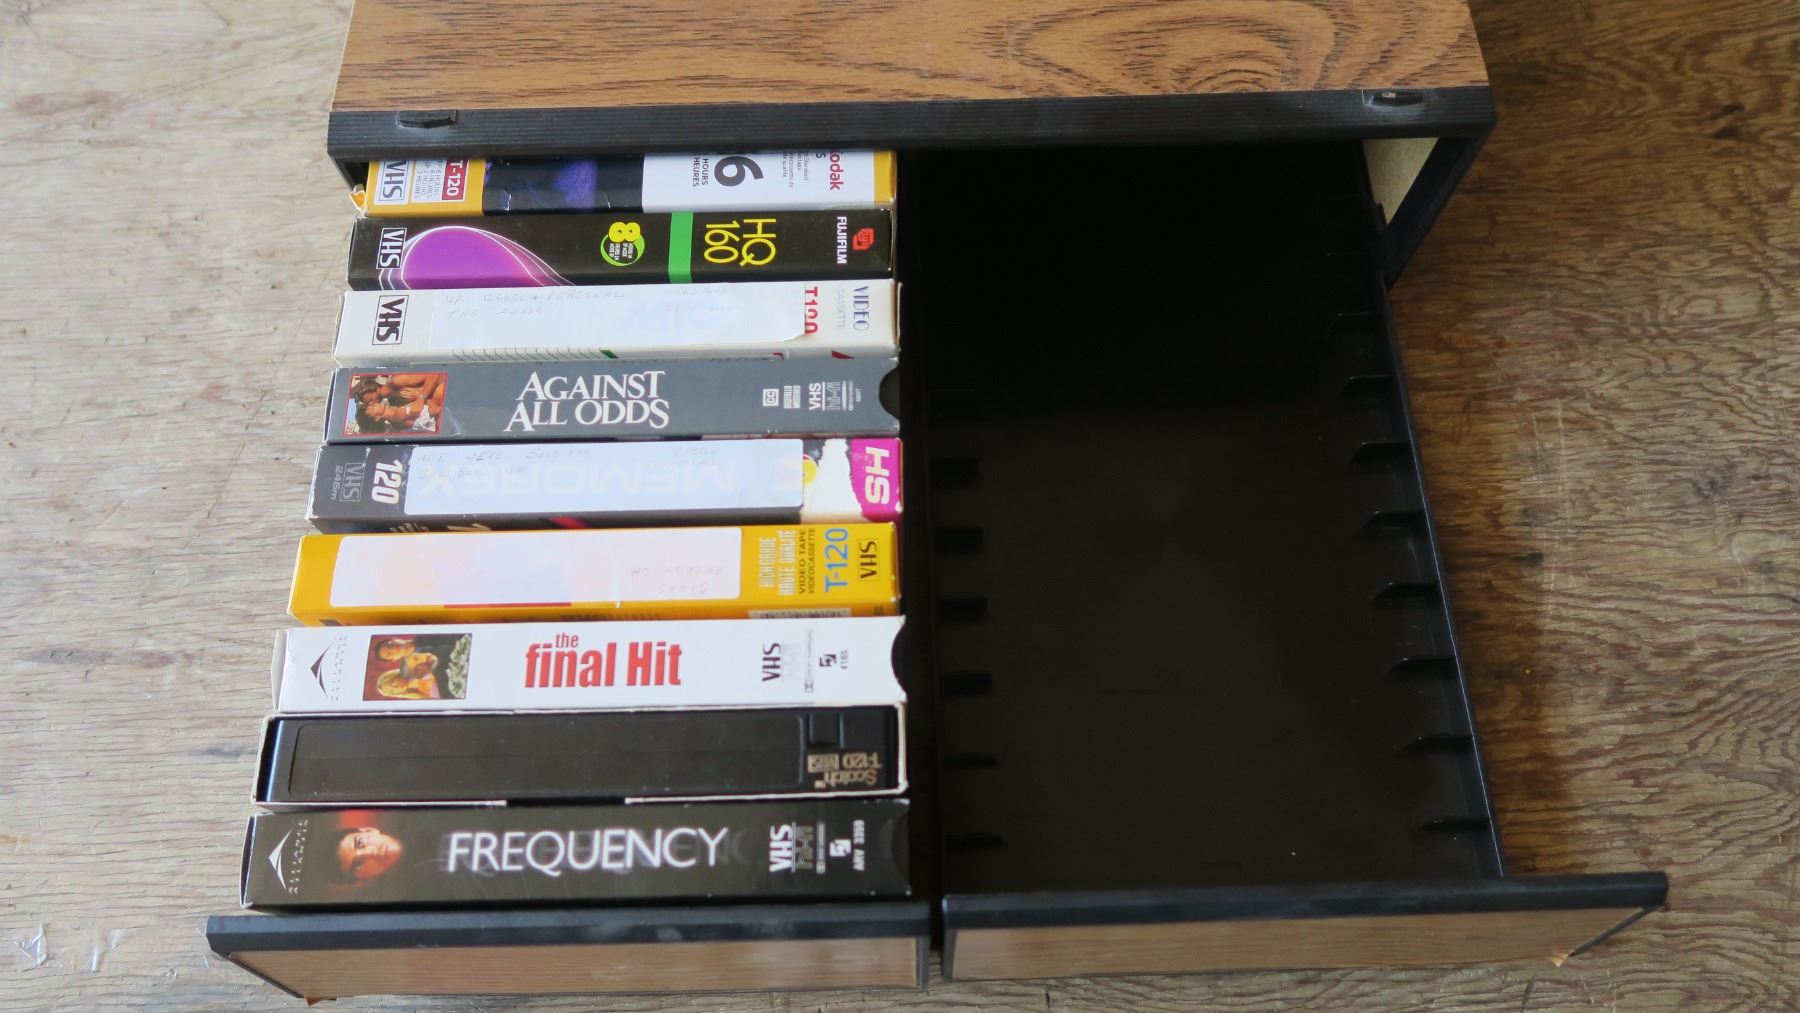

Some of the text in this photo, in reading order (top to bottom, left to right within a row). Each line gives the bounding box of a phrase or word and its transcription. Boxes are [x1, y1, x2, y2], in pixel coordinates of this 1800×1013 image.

[382, 160, 407, 199] VHS
[446, 160, 464, 197] T-120
[693, 157, 701, 188] HEURES
[701, 158, 709, 186] HOURS
[714, 156, 764, 187] 6
[379, 229, 405, 267] VHS
[608, 222, 641, 242] 8
[703, 220, 741, 263] 160
[740, 218, 777, 267] HQ
[836, 216, 848, 264] FUJIFILM
[375, 297, 406, 343] VHS
[853, 286, 870, 332] VIDEO
[516, 371, 666, 401] AGAINST
[808, 382, 822, 411] VHS
[504, 399, 670, 432] ALL ODDS
[330, 465, 342, 501] 246m
[343, 464, 363, 501] VHS
[371, 459, 403, 504] 120
[865, 446, 890, 504] HS
[798, 528, 807, 595] VIDEO TAPE
[824, 528, 849, 592] T-120
[860, 540, 878, 579] VHS
[778, 566, 795, 596] HAUTE
[556, 632, 579, 648] the
[524, 641, 683, 688] final Hit
[762, 643, 781, 682] VHS
[823, 768, 878, 787] Scotch
[842, 752, 882, 769] T-120
[447, 826, 730, 878] FREQUENCY
[769, 823, 792, 873] VHS
